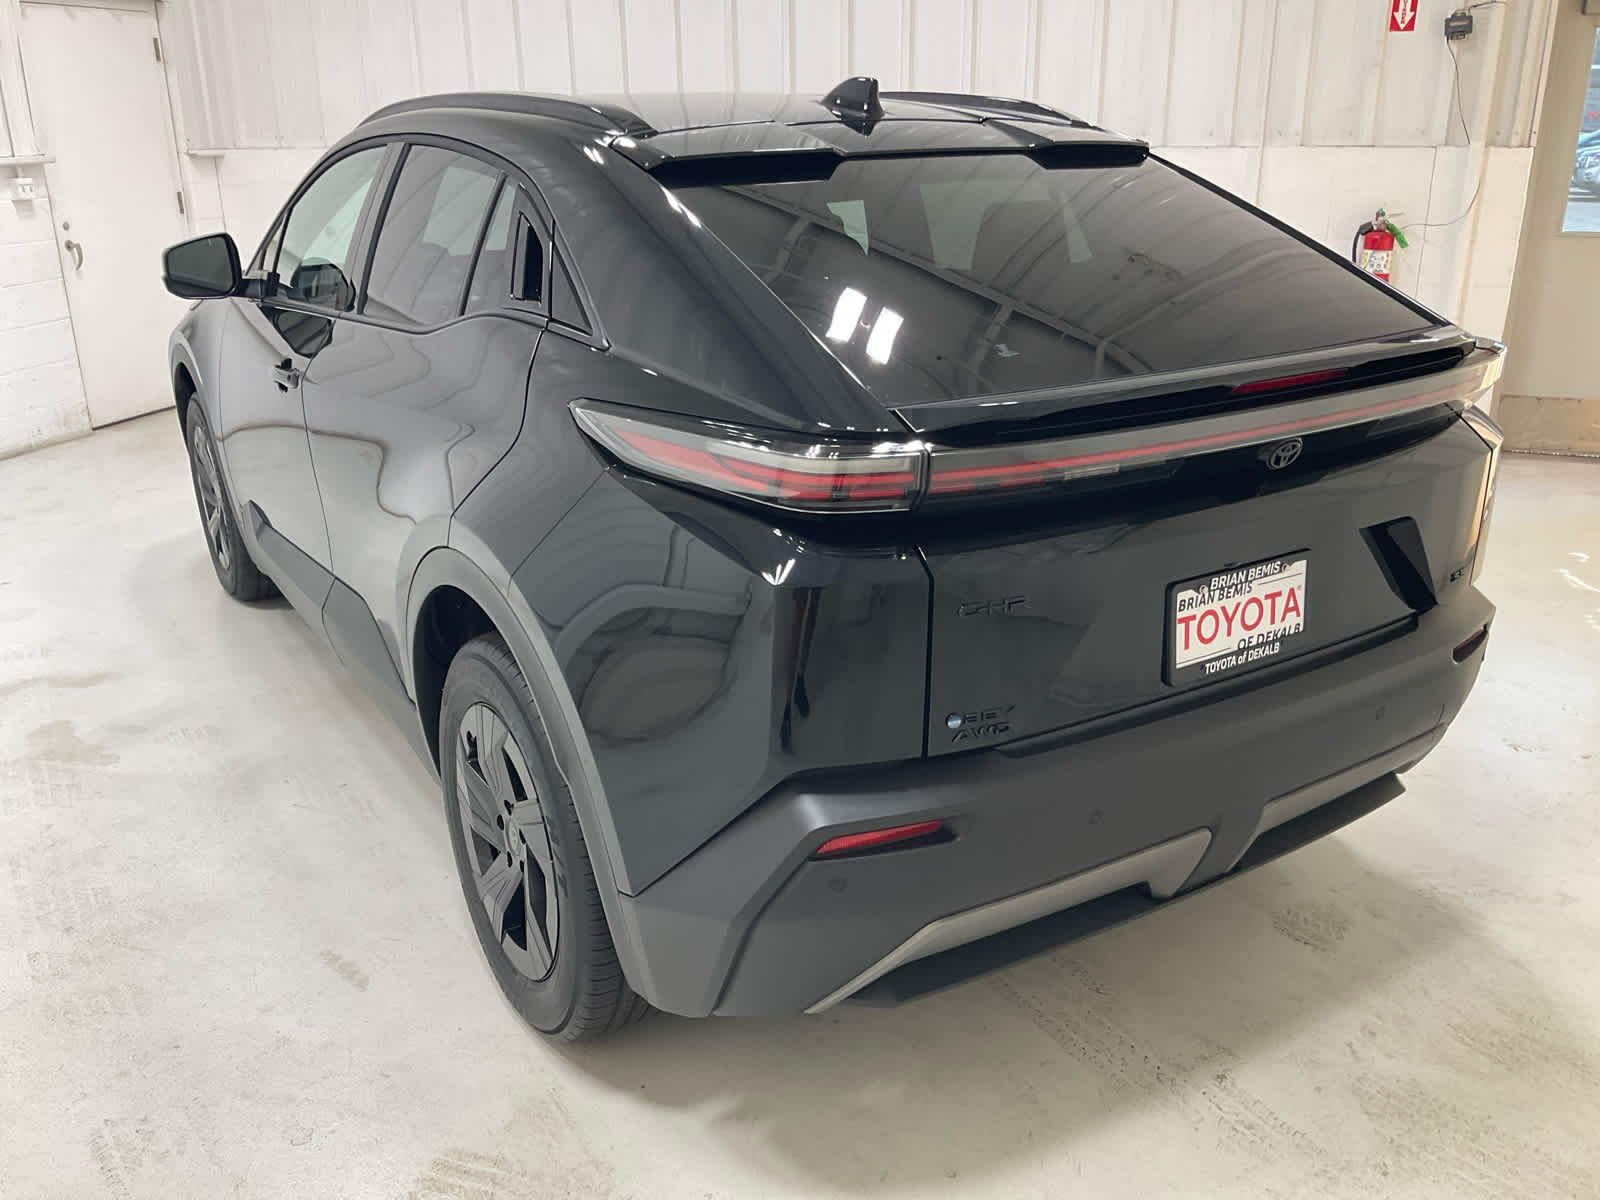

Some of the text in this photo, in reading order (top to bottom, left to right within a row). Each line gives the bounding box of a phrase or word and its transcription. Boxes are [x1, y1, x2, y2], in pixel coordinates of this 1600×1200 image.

[1210, 561, 1281, 590] BRIAN BEMIS
[1178, 582, 1252, 612] BRIAN BEMIS
[1177, 587, 1301, 650] TOYOTA
[1205, 642, 1280, 674] TOYOTA of DEKALB
